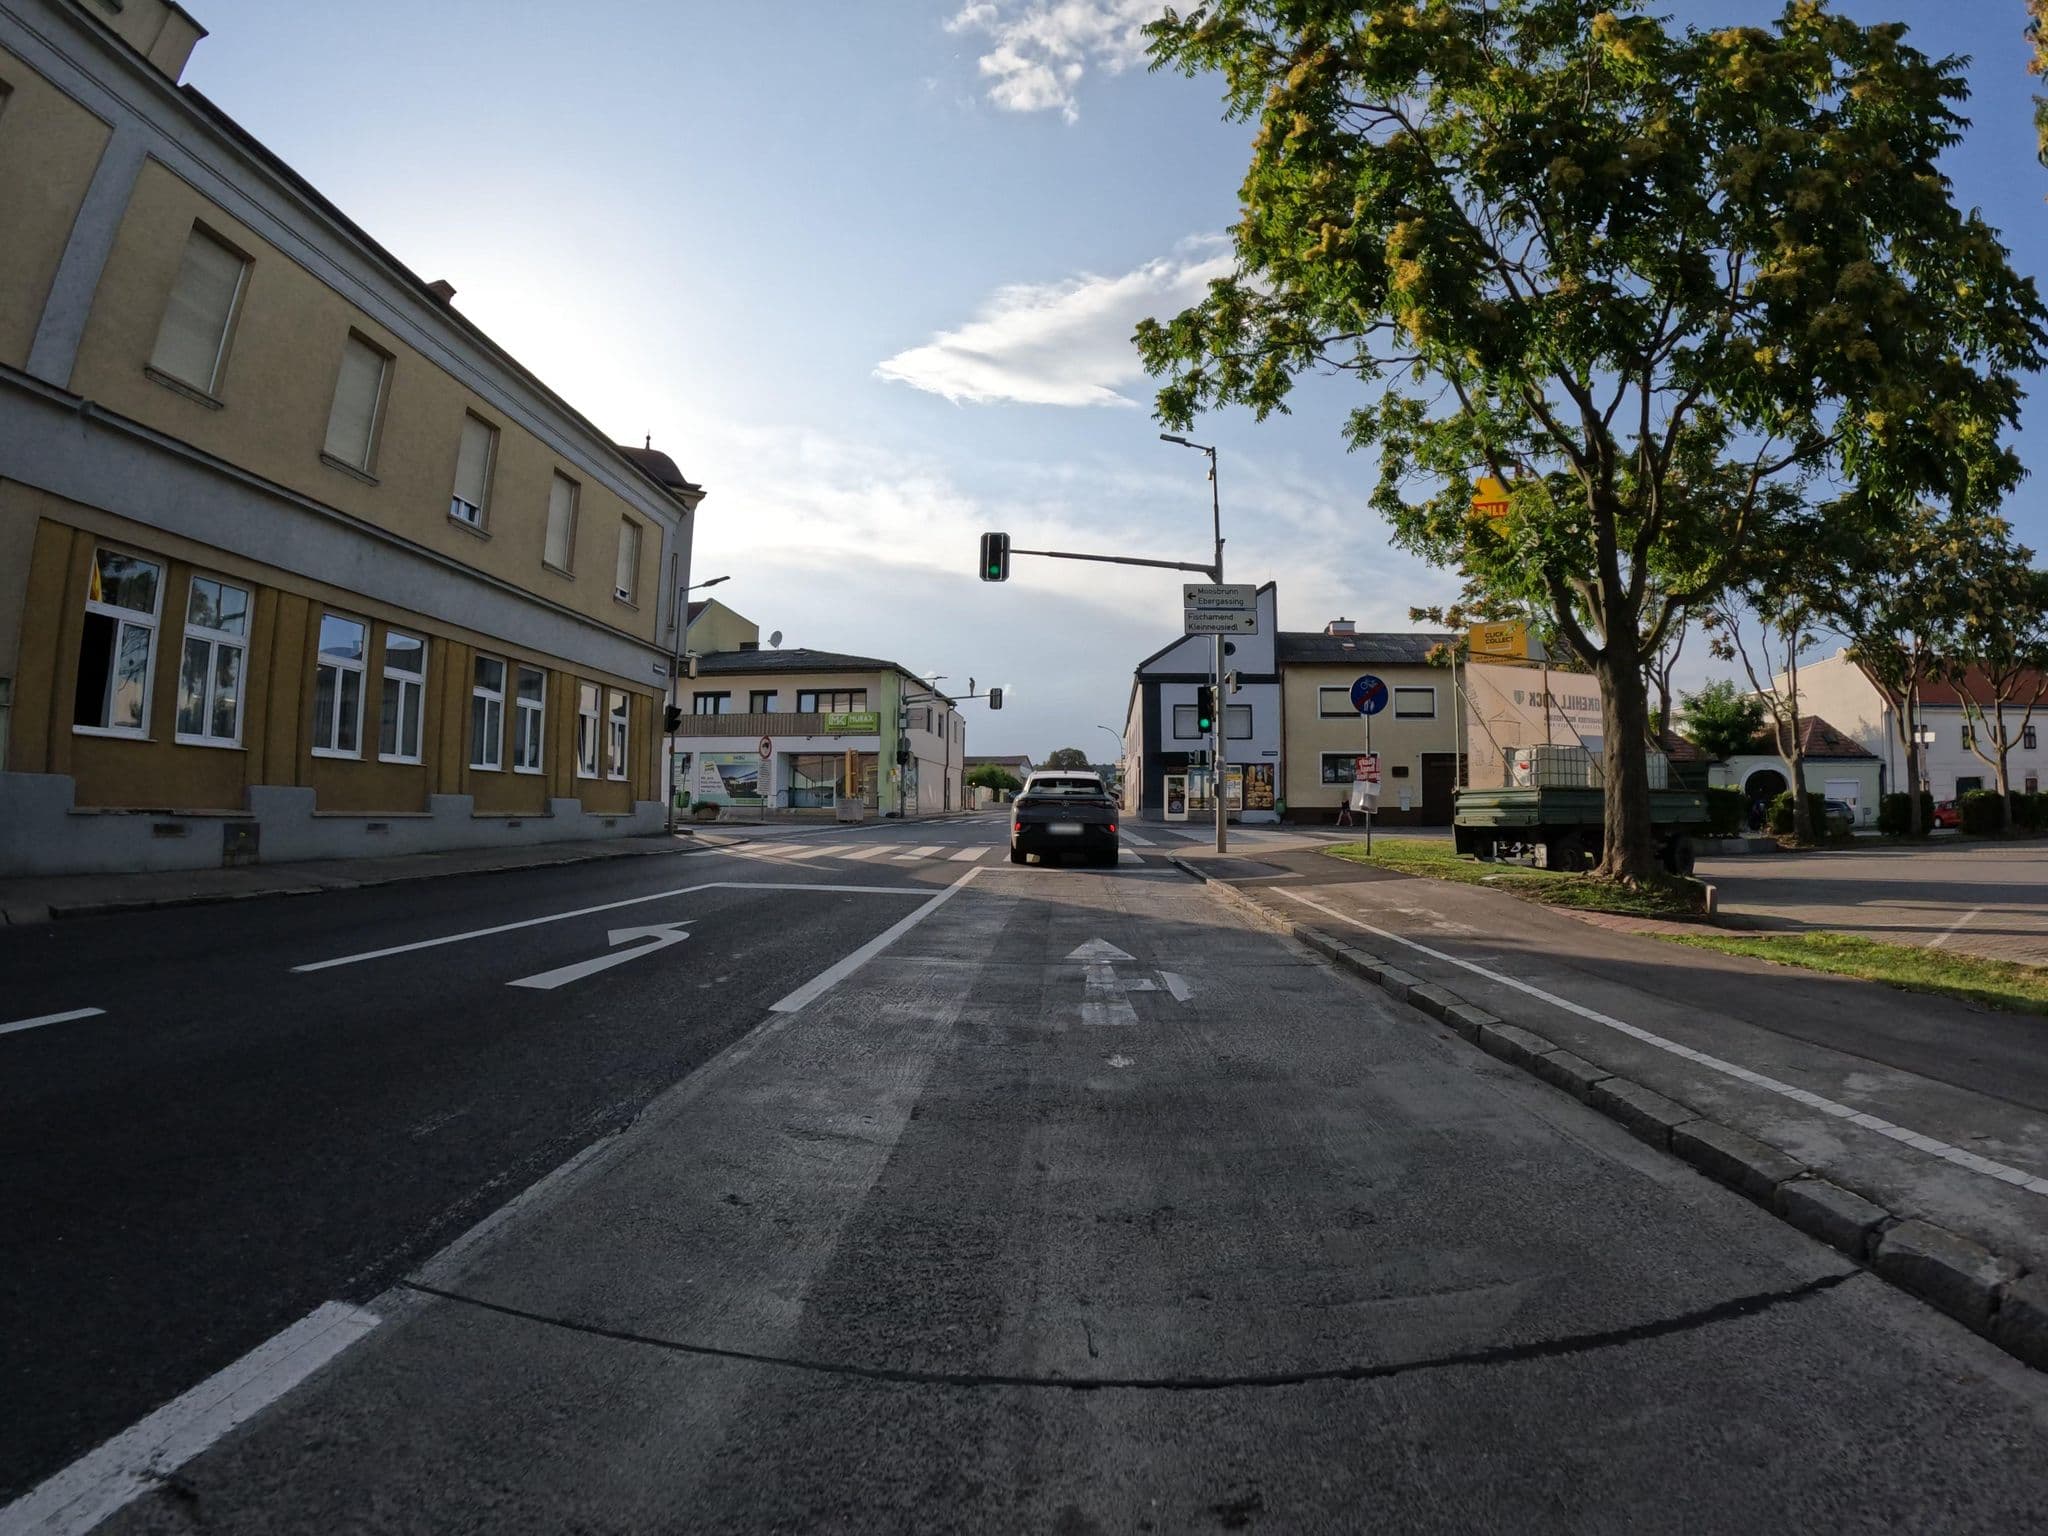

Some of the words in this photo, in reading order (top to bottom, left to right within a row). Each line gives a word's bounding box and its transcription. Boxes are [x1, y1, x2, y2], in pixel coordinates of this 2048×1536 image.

[1197, 587, 1239, 595] Moosbrunn
[1198, 598, 1244, 606] Ebergassing
[1188, 613, 1234, 621] Fischamend
[1188, 623, 1239, 631] Kleinneusiedl
[1485, 631, 1504, 639] CLICK
[1485, 636, 1514, 645] COLLECT
